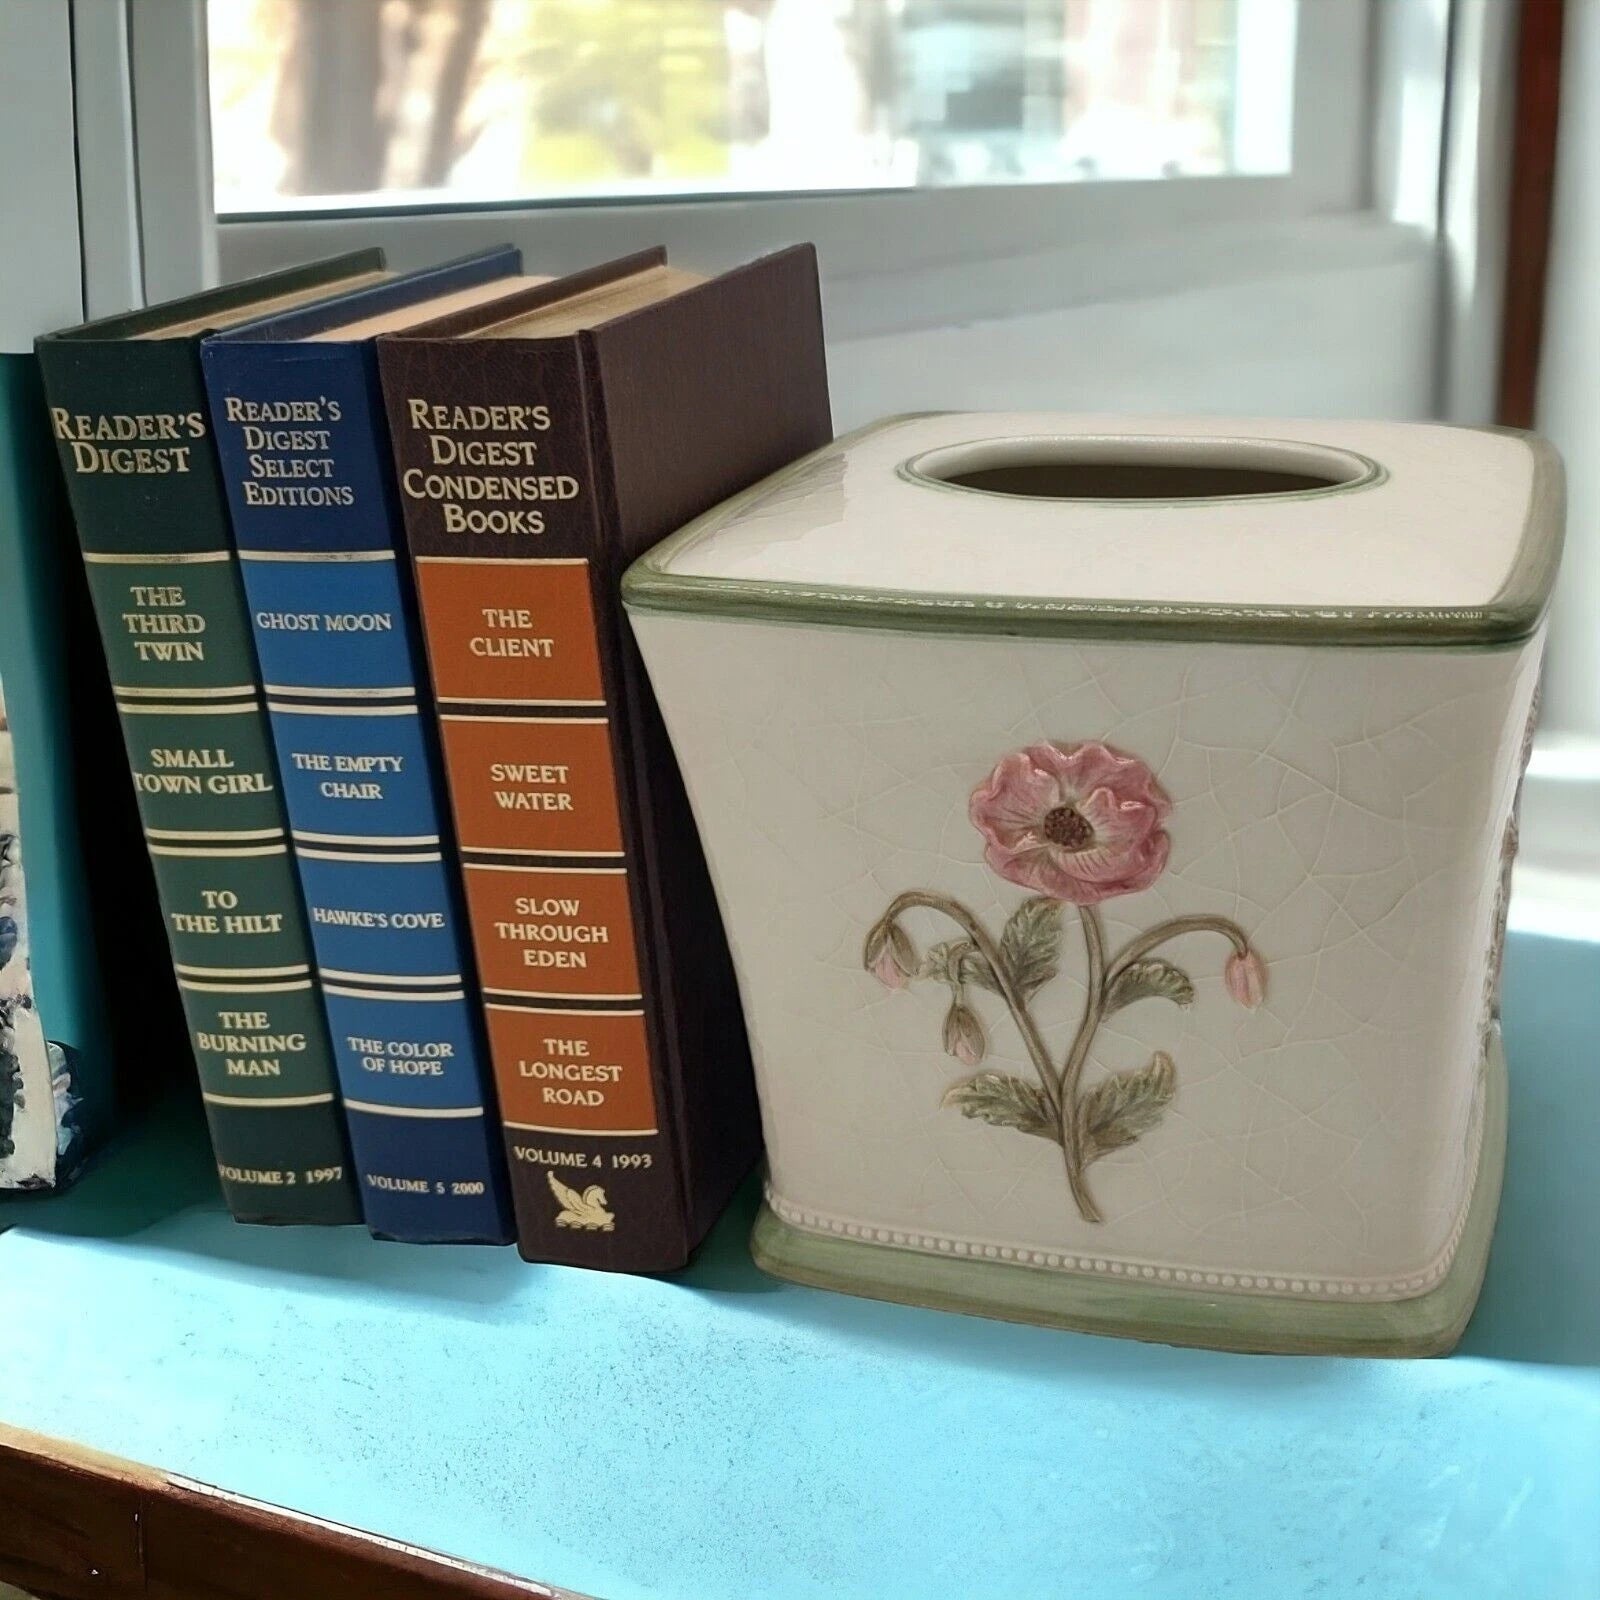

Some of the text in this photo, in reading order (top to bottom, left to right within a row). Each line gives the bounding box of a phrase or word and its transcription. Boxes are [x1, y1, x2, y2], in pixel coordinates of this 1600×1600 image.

[225, 396, 341, 422] READER'S
[408, 399, 550, 430] READER'S
[51, 408, 205, 440] READER'S
[243, 427, 330, 450] DIGEST
[71, 442, 190, 474] DIGEST
[430, 435, 537, 465] DIGEST
[249, 454, 334, 477] SELECT
[243, 482, 353, 505] EDITIONS
[404, 469, 579, 500] CONDENSED
[443, 504, 544, 533] BOOKS
[130, 587, 185, 606] THE
[122, 614, 205, 633] THIRD
[257, 612, 391, 631] GHOST MOON
[482, 609, 532, 628] THE
[134, 642, 204, 661] TWIN
[470, 638, 553, 657] CLIENT
[151, 749, 234, 767] SMALL
[292, 753, 403, 772] THE EMPTY
[491, 764, 568, 783] SWEET
[208, 774, 273, 794] GIRL
[321, 782, 383, 799] CHAIR
[495, 792, 573, 810] WATER
[202, 891, 237, 908] TO
[516, 898, 579, 915] SLOW
[171, 913, 282, 933] THE HILT
[313, 908, 445, 928] HAWKE'S COVE
[495, 922, 608, 942] THROUGH
[524, 949, 586, 967] EDEN
[218, 1012, 270, 1029] THE
[197, 1032, 306, 1052] BURNING
[347, 1037, 453, 1058] THE COLOR
[543, 1039, 589, 1056] THE
[226, 1059, 280, 1076] MAN
[363, 1057, 443, 1075] OF HOPE
[520, 1061, 622, 1081] LONGEST
[543, 1088, 604, 1106] ROAD
[514, 1146, 651, 1168] VOLUME 4 1993
[287, 1172, 295, 1184] 2
[306, 1167, 342, 1183] 1997
[367, 1175, 484, 1194] VOLUME 5 2000
